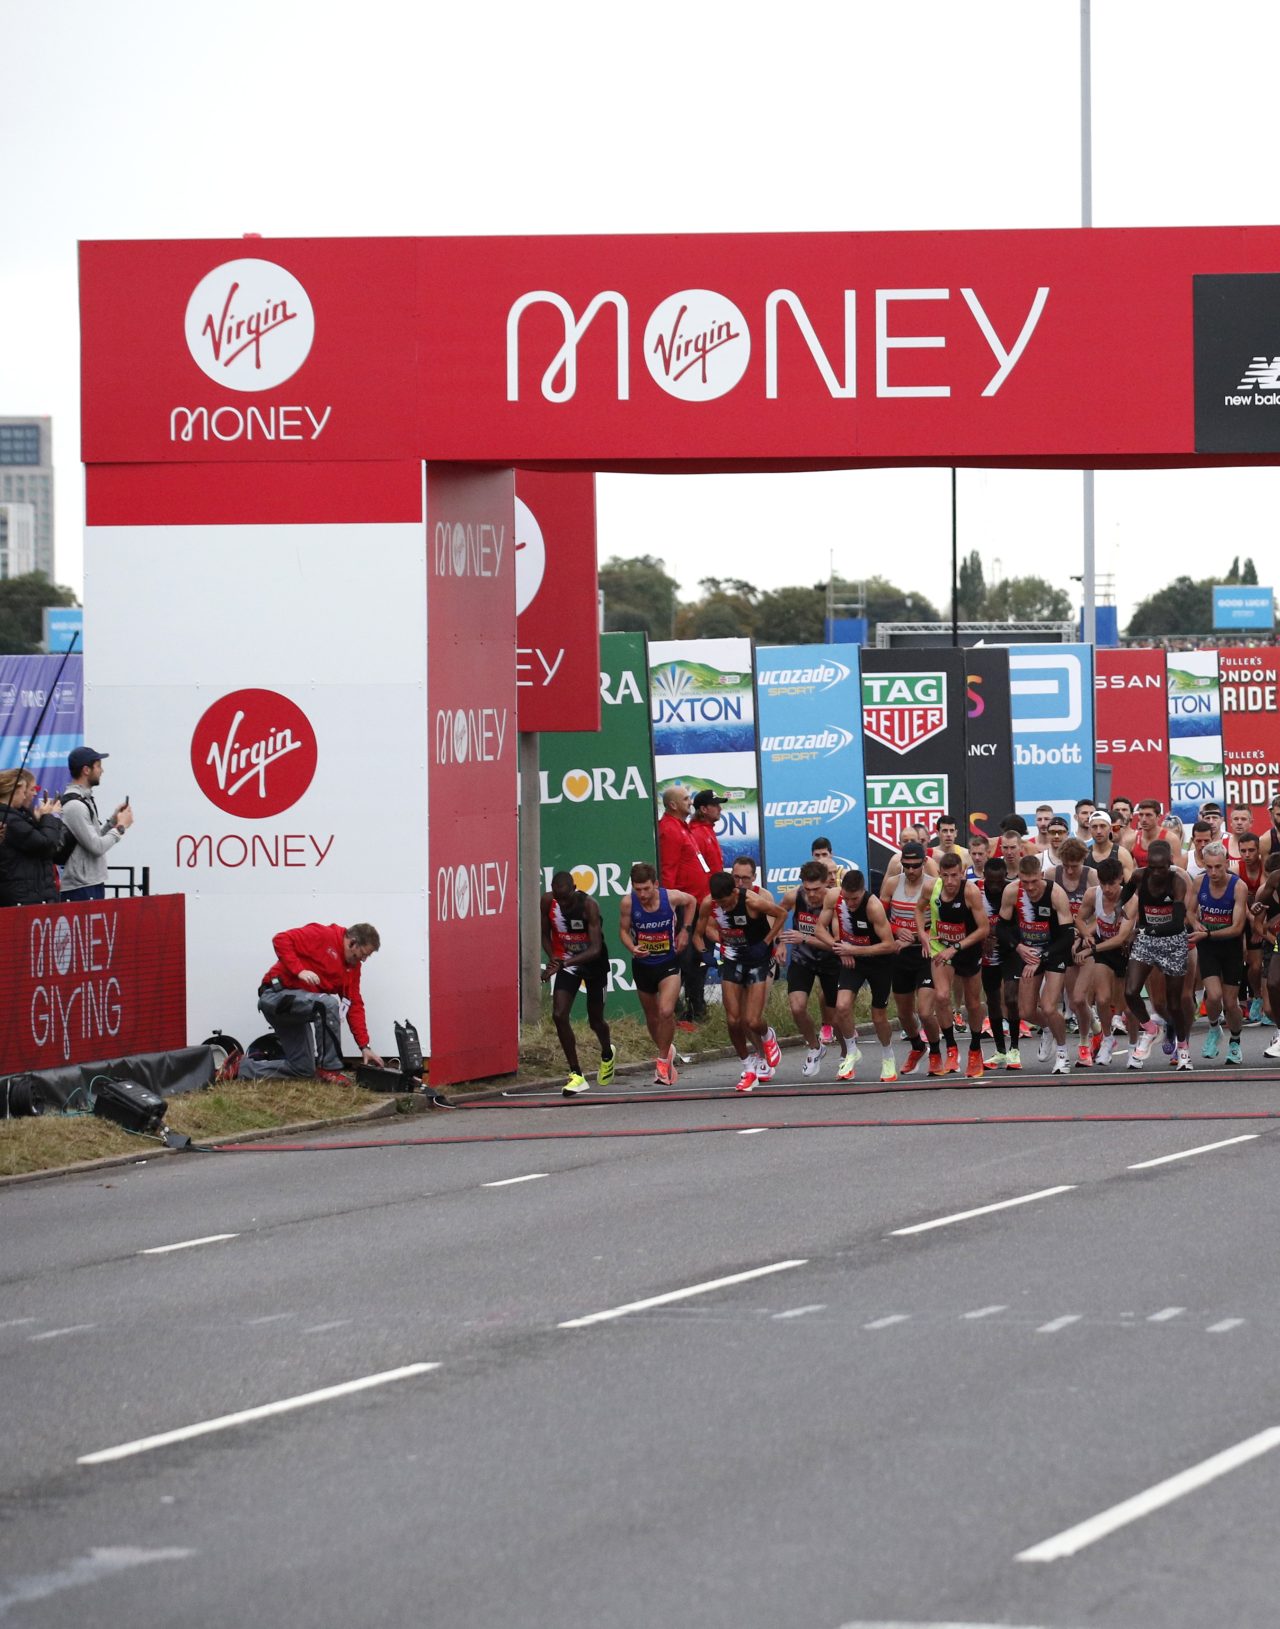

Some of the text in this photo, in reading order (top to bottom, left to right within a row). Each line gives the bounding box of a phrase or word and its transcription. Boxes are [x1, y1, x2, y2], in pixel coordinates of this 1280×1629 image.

[202, 282, 297, 368] Virgin
[507, 287, 1050, 402] MONEY
[654, 304, 740, 383] Virgin
[1225, 394, 1262, 405] new
[171, 406, 331, 441] MONEY
[435, 521, 505, 577] MONEY
[1220, 656, 1263, 666] FULLER'S
[758, 664, 835, 686] ucozade
[768, 686, 816, 697] SPORT
[864, 679, 938, 703] TAG
[1223, 685, 1277, 712] RIDE
[437, 708, 507, 764] MONEY
[761, 730, 838, 752] ucozade
[864, 709, 941, 748] HEUER
[206, 711, 301, 798] Virgin
[771, 751, 818, 763] SPORT
[518, 766, 649, 805] LORA
[867, 781, 938, 805] TAG
[1226, 779, 1280, 805] RIDE
[764, 795, 841, 817] ucozade
[774, 816, 823, 828] SPORT
[177, 834, 335, 868] MONEY
[437, 861, 509, 922] MONEY
[1201, 905, 1233, 915] CARDIFF
[635, 919, 671, 930] CARDIFF
[31, 912, 117, 978] MONEY
